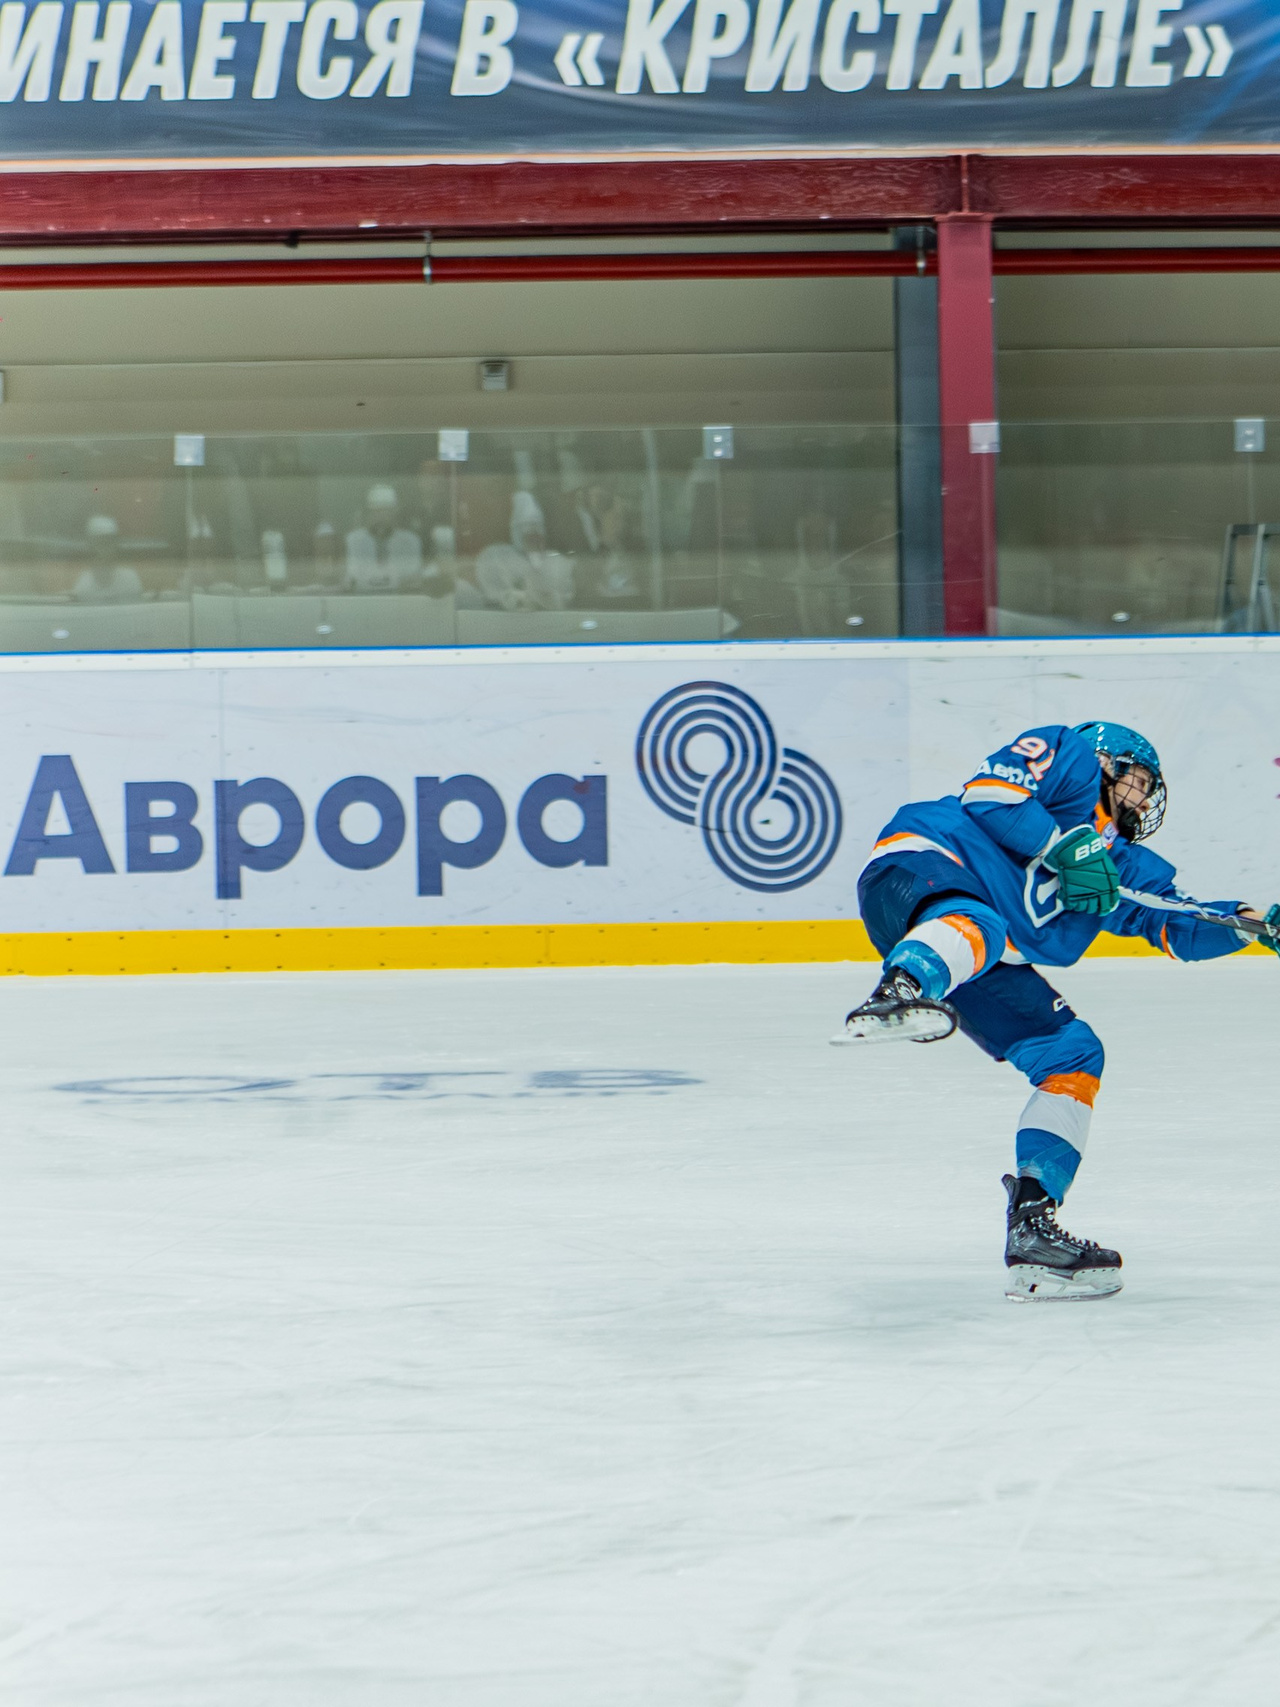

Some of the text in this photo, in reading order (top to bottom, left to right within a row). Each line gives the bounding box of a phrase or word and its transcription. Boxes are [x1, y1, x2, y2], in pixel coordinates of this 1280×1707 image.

[450, 0, 518, 96] В
[552, 0, 1233, 94] «КРИСТАЛЛЕ»
[1010, 736, 1056, 782] 91
[4, 754, 608, 901] Аврора
